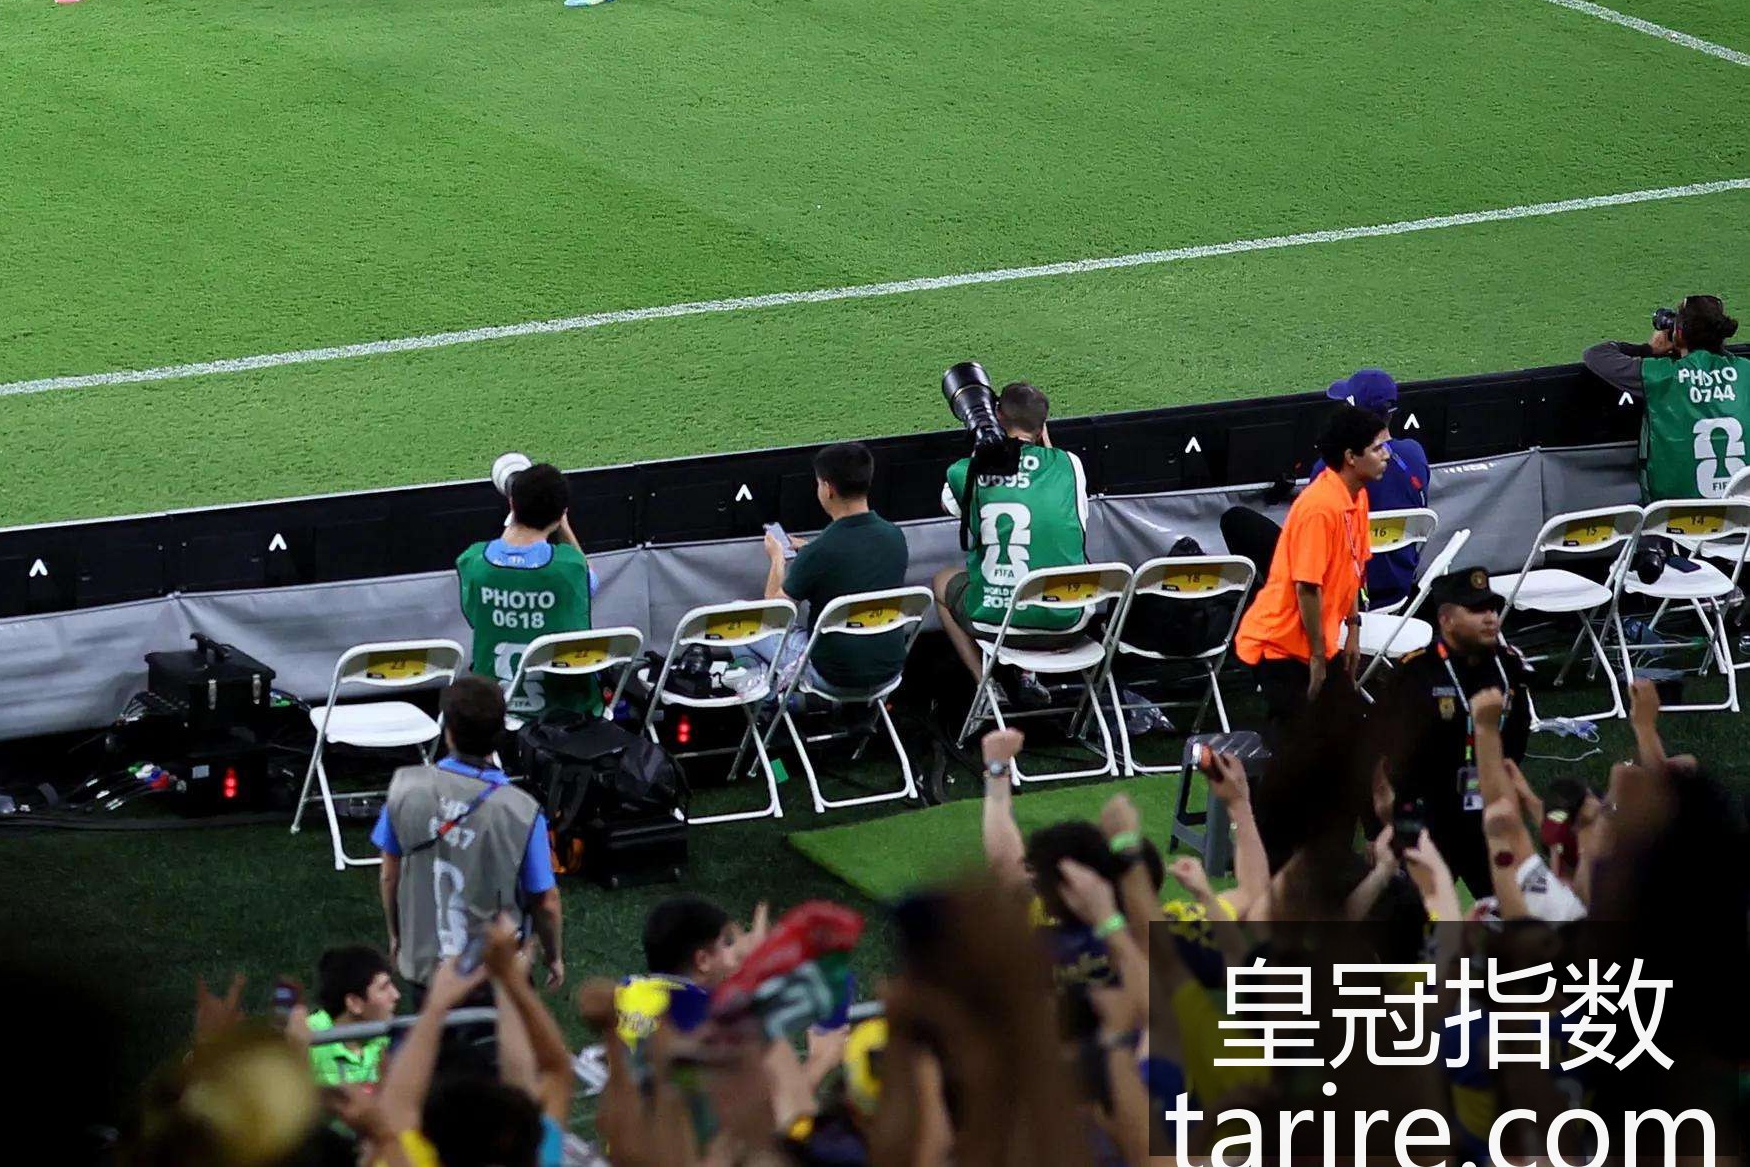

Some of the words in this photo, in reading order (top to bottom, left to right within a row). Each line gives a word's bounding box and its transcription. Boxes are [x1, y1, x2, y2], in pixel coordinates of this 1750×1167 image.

[1678, 366, 1738, 386] PHOTO
[1689, 384, 1736, 404] 0744
[1712, 481, 1728, 492] FIF
[1374, 527, 1387, 538] 16
[993, 569, 1015, 579] FIFA
[481, 586, 556, 609] PHOTO
[983, 586, 1010, 597] WORLD
[492, 609, 545, 630] 0618
